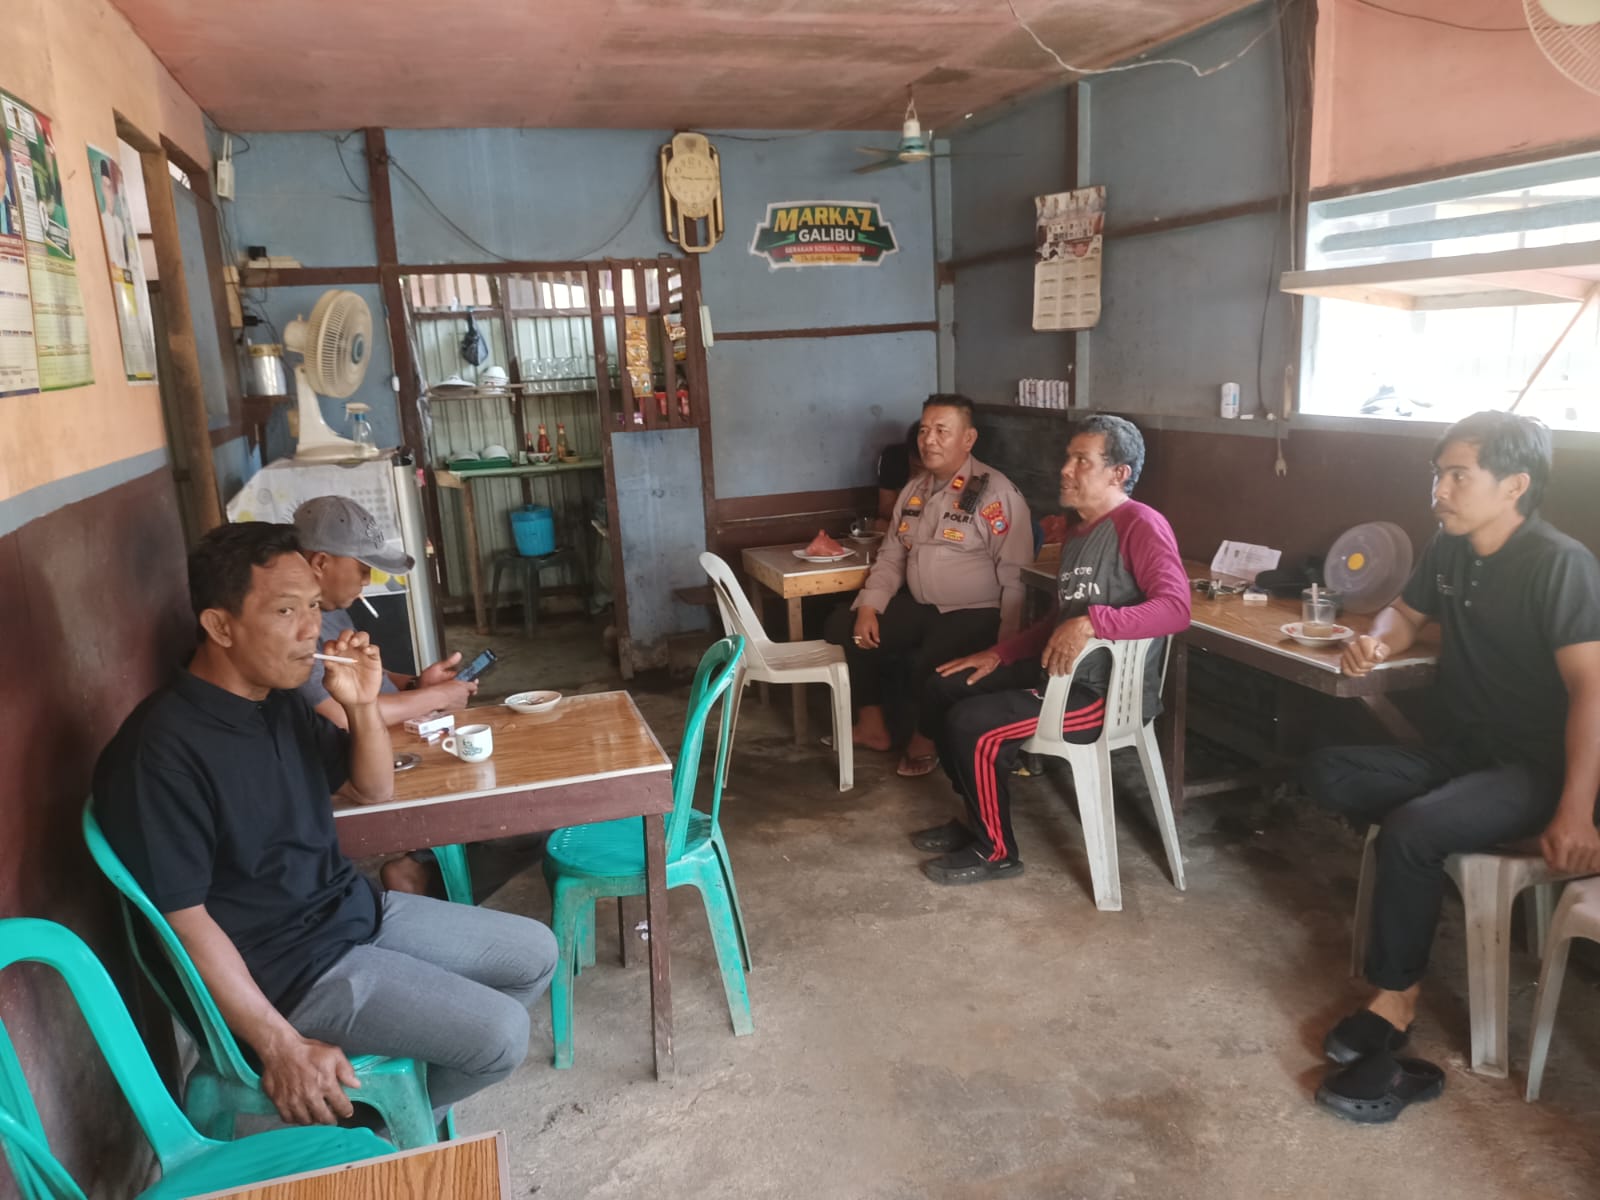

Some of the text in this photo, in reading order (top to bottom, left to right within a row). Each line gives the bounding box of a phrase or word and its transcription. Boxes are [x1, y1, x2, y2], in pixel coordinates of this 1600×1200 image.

[773, 207, 876, 232] MARKAZ
[798, 228, 856, 242] GALIBU
[943, 512, 973, 524] POLRI
